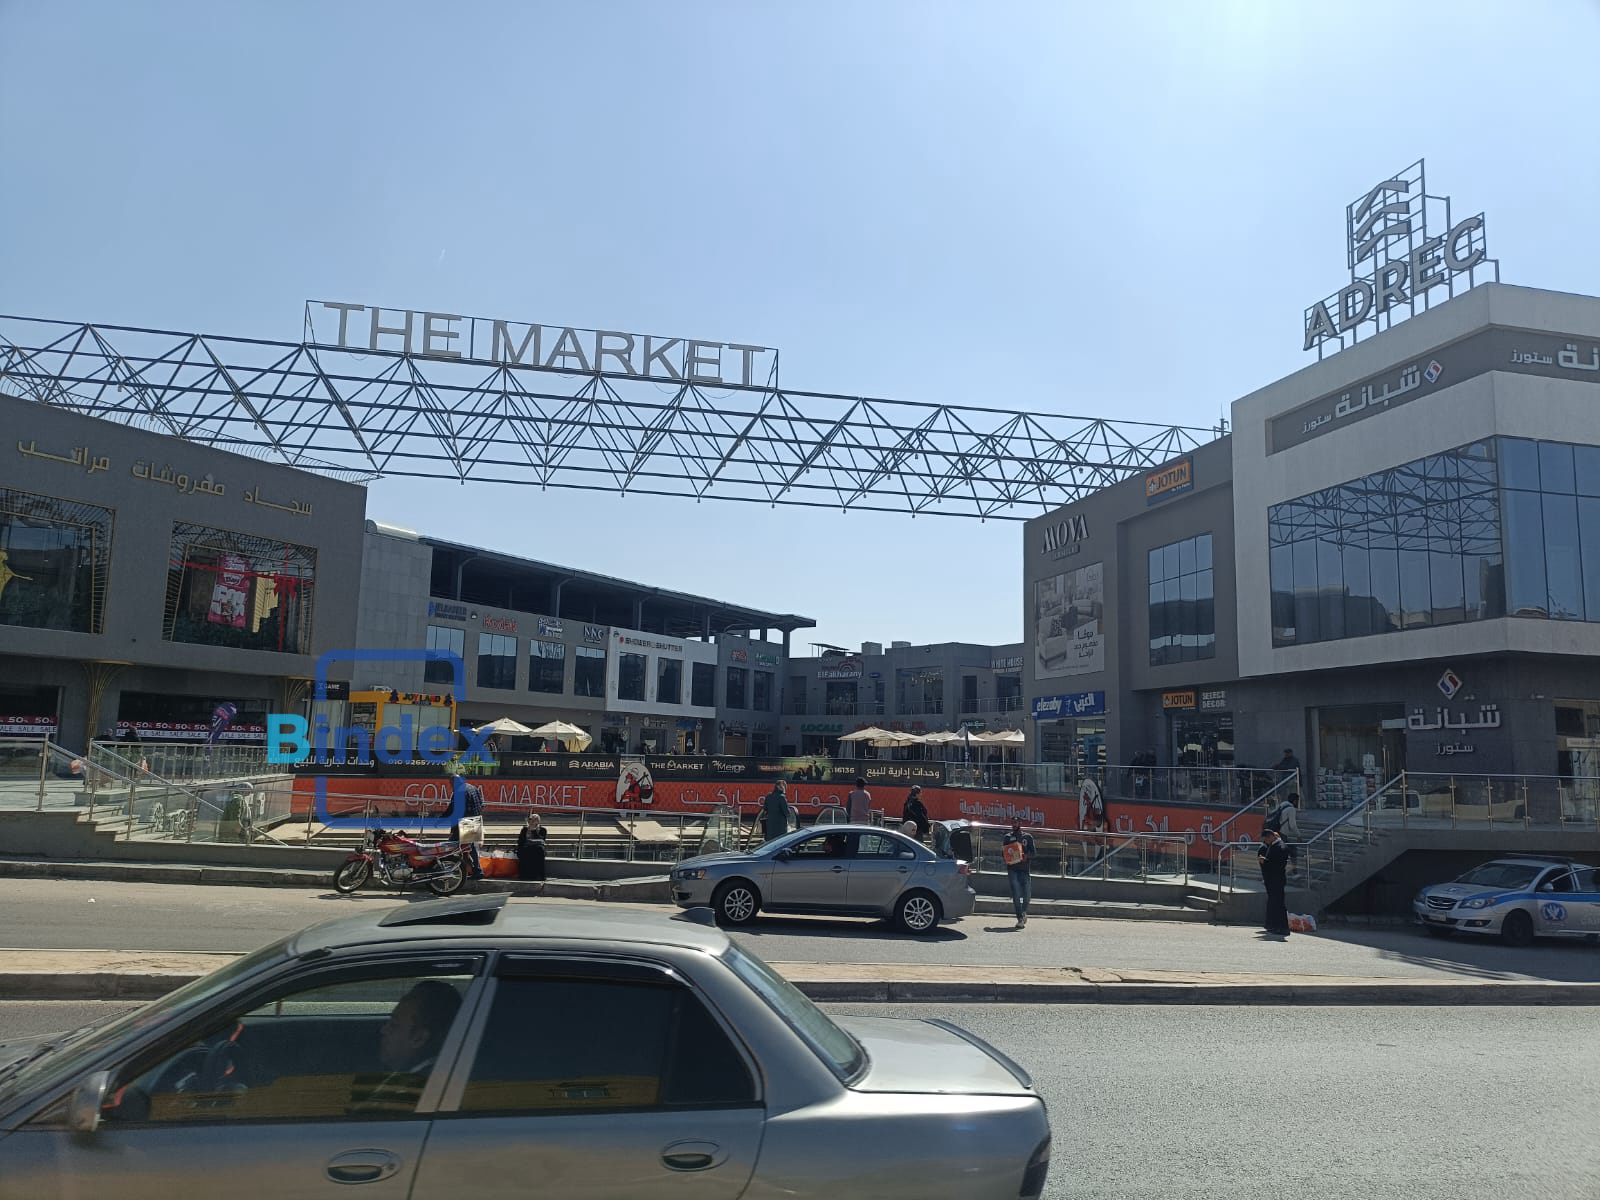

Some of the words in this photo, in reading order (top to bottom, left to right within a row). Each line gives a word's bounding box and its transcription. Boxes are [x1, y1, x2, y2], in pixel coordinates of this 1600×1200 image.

[1303, 217, 1486, 351] ADREC
[324, 302, 462, 358] THE
[492, 319, 766, 387] MARKET
[1510, 349, 1552, 364] ستورز
[1335, 365, 1420, 418] شبانة
[1302, 412, 1332, 433] ستورز
[131, 459, 225, 496] مفروشات
[1156, 467, 1186, 490] JOTUN
[1041, 513, 1089, 555] MOVA
[1171, 694, 1193, 705] JOTUN
[1408, 704, 1500, 735] شبانة
[1436, 743, 1474, 755] ستورز
[294, 755, 316, 768] للبيع
[319, 755, 346, 768] تجارية
[347, 756, 375, 768] وحدات
[667, 760, 704, 770] MARKET
[866, 766, 886, 778] للبيع
[888, 767, 910, 779] إدارية
[912, 767, 940, 779] وحدات
[500, 785, 586, 809] MARKET
